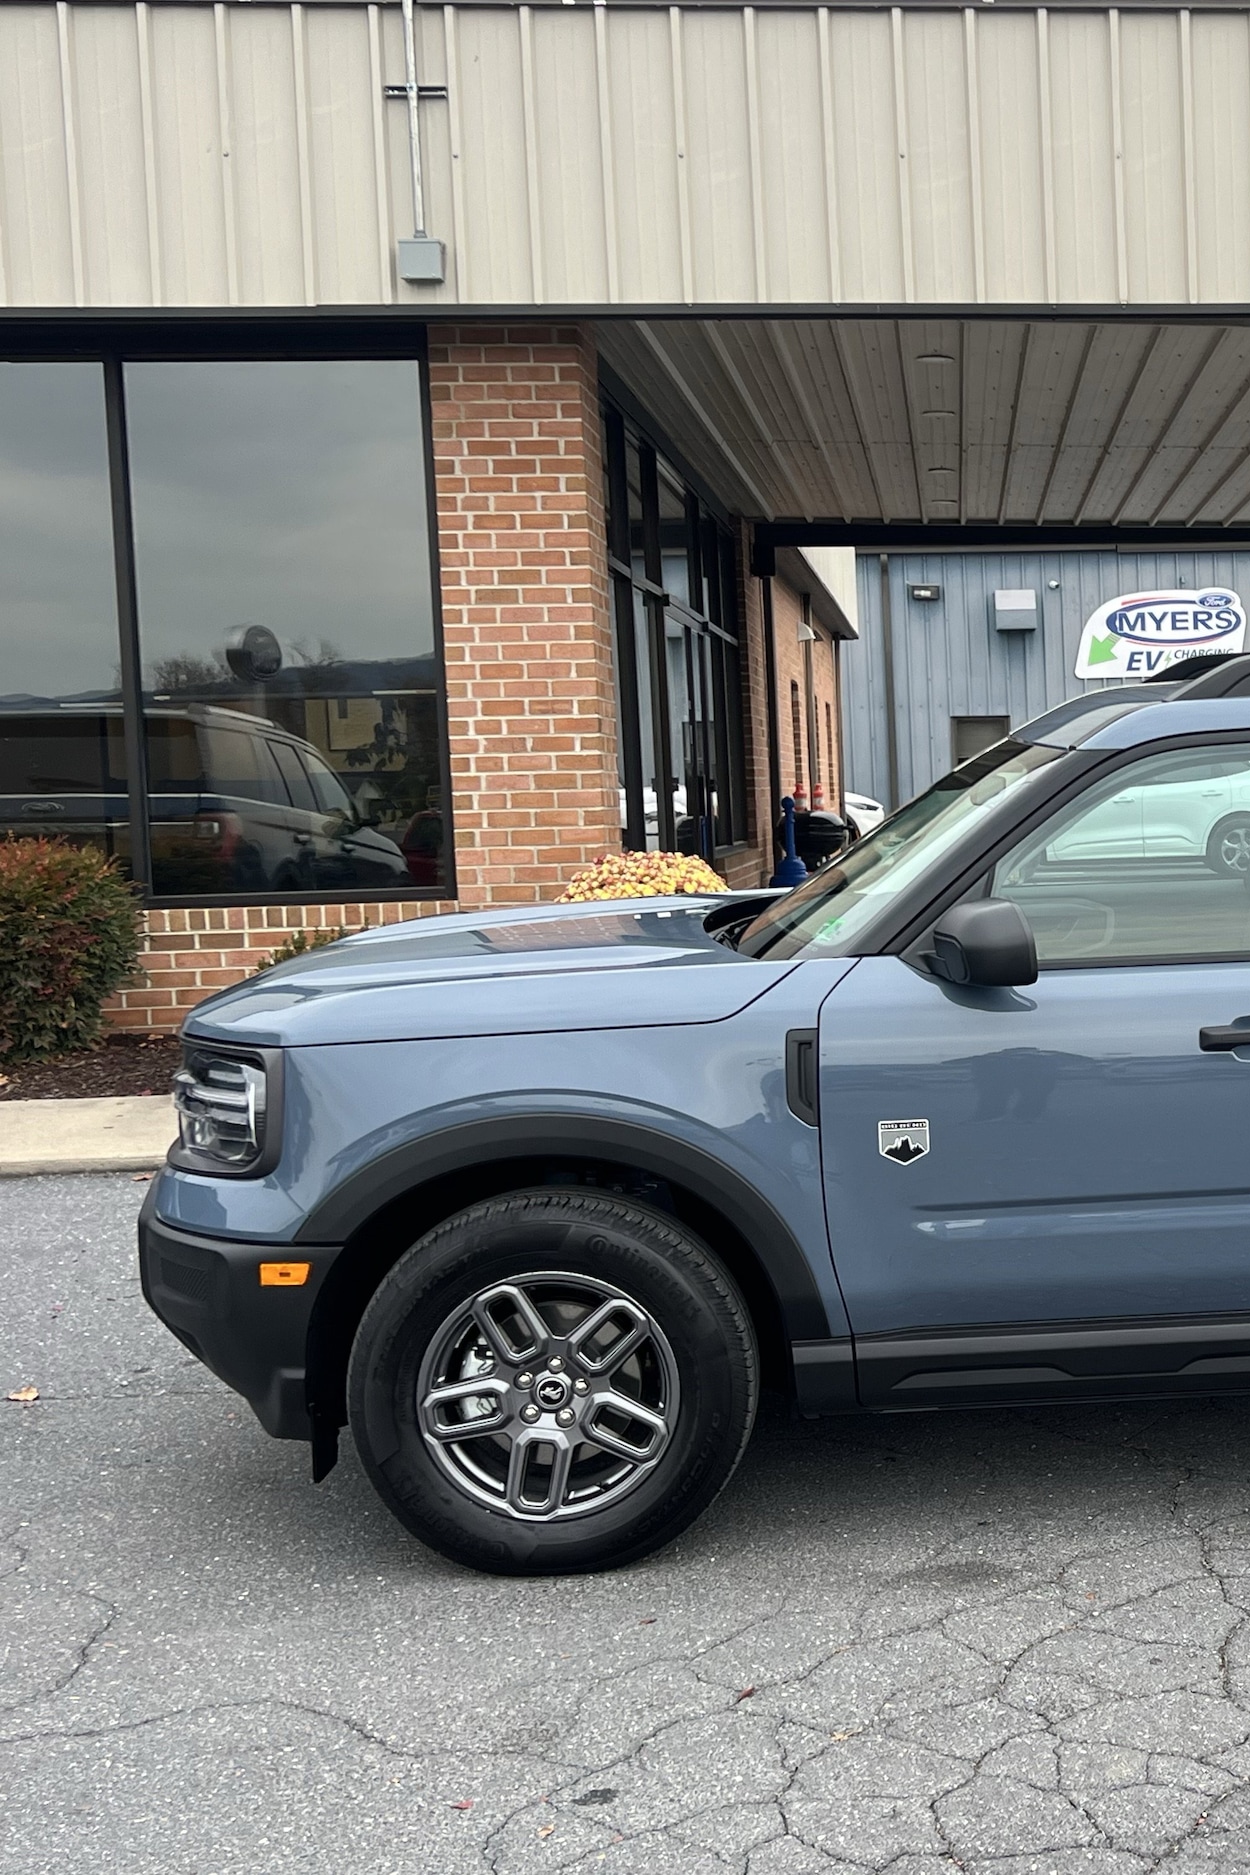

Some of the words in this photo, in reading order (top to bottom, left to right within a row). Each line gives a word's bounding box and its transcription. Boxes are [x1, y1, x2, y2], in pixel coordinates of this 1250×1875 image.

[1204, 596, 1226, 607] Ford
[1118, 611, 1232, 632] MYERS
[1126, 650, 1164, 672] EV
